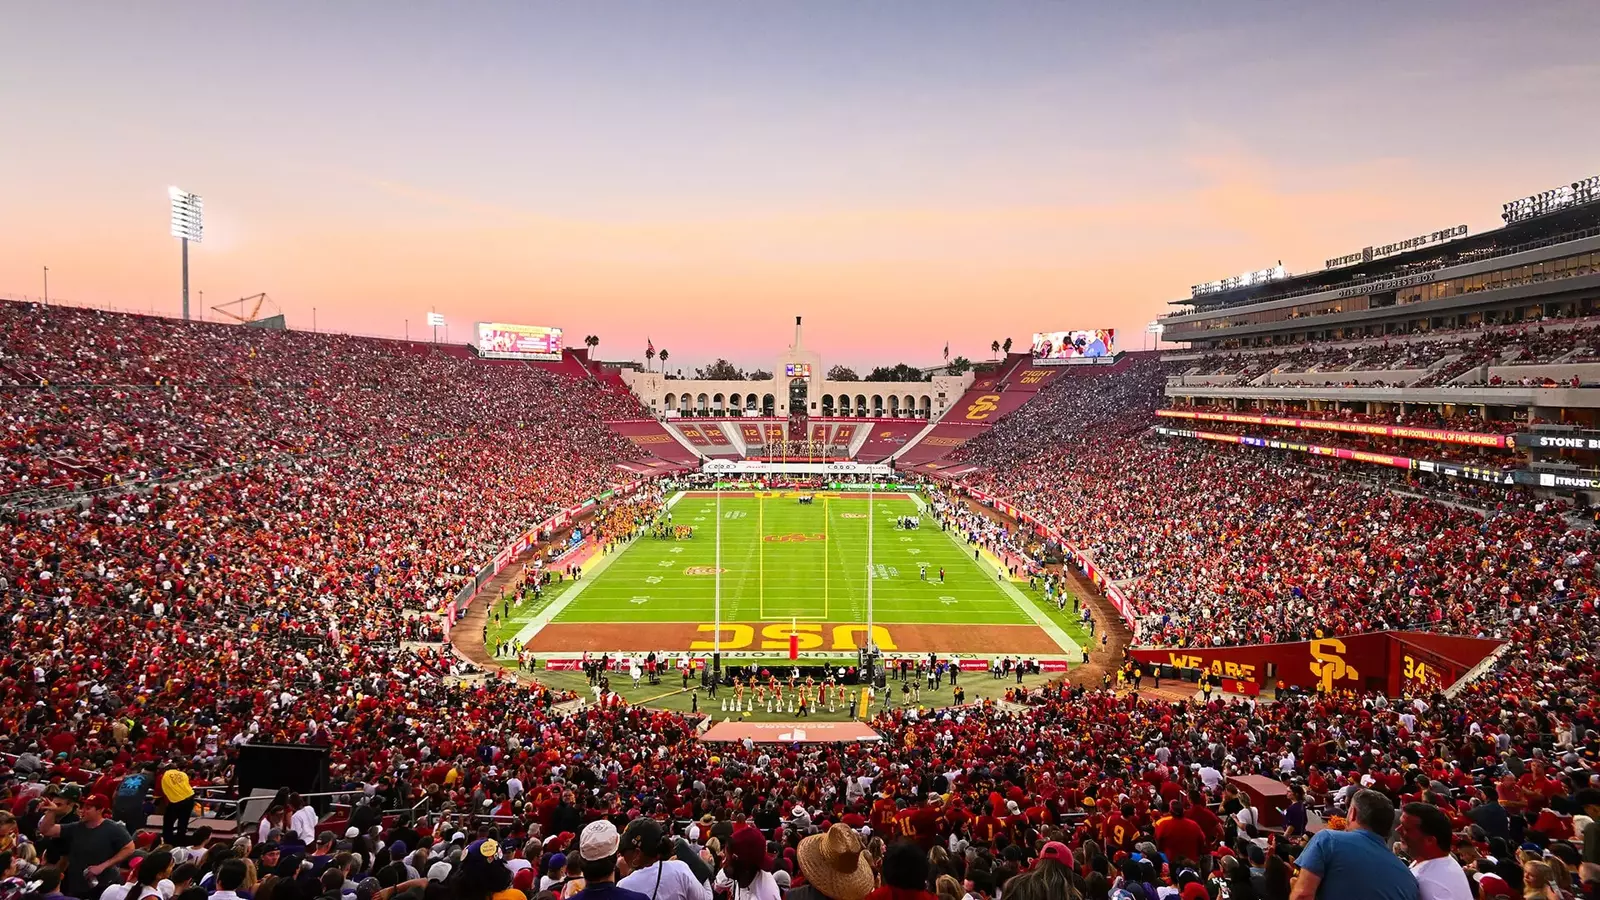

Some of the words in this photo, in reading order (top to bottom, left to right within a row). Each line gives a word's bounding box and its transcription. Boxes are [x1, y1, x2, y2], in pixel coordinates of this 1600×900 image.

[1326, 253, 1361, 268] UNITED
[1374, 236, 1426, 256] AIRLINES
[1432, 225, 1467, 243] FIELD
[1338, 288, 1354, 297] OTIS
[1358, 282, 1383, 294] BOOTH
[1387, 278, 1413, 290] PRESS
[1417, 273, 1435, 284] BOX
[1020, 376, 1042, 384] ON!
[684, 430, 700, 438] 20
[706, 429, 722, 437] 32
[745, 429, 758, 437] 12
[767, 429, 782, 437] 33
[1409, 430, 1433, 439] FOOTBALL
[1433, 432, 1447, 440] HALL
[1455, 434, 1470, 443] FAME
[1470, 436, 1497, 445] MEMBERS
[1540, 437, 1583, 448] STONE
[690, 624, 897, 650] USC
[1403, 655, 1427, 684] 34
[1113, 824, 1125, 845] 9
